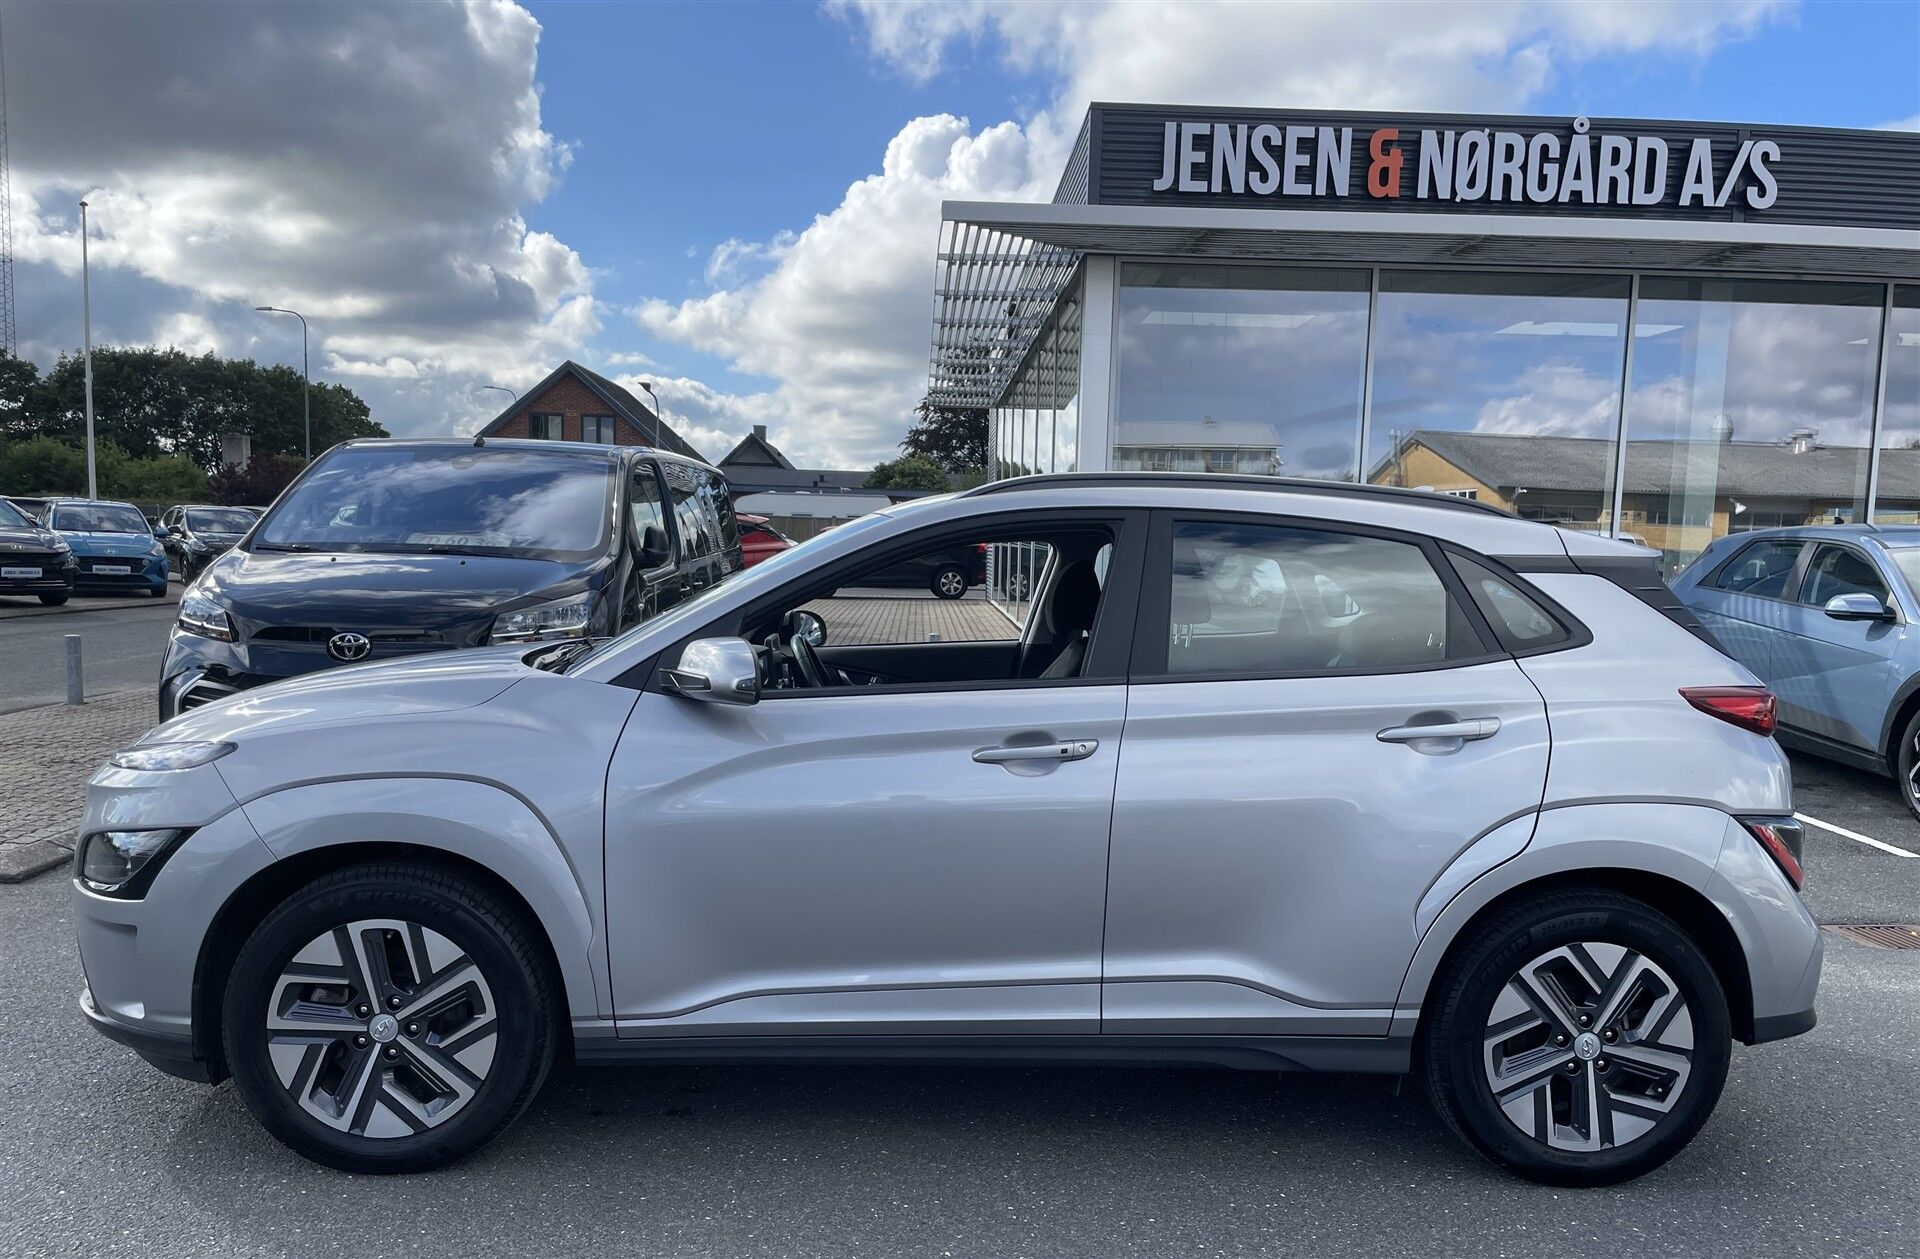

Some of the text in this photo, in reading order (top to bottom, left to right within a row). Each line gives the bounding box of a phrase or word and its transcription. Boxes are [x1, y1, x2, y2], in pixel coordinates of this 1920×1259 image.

[1153, 115, 1781, 210] JENSEN & NØRGÅRD A/S
